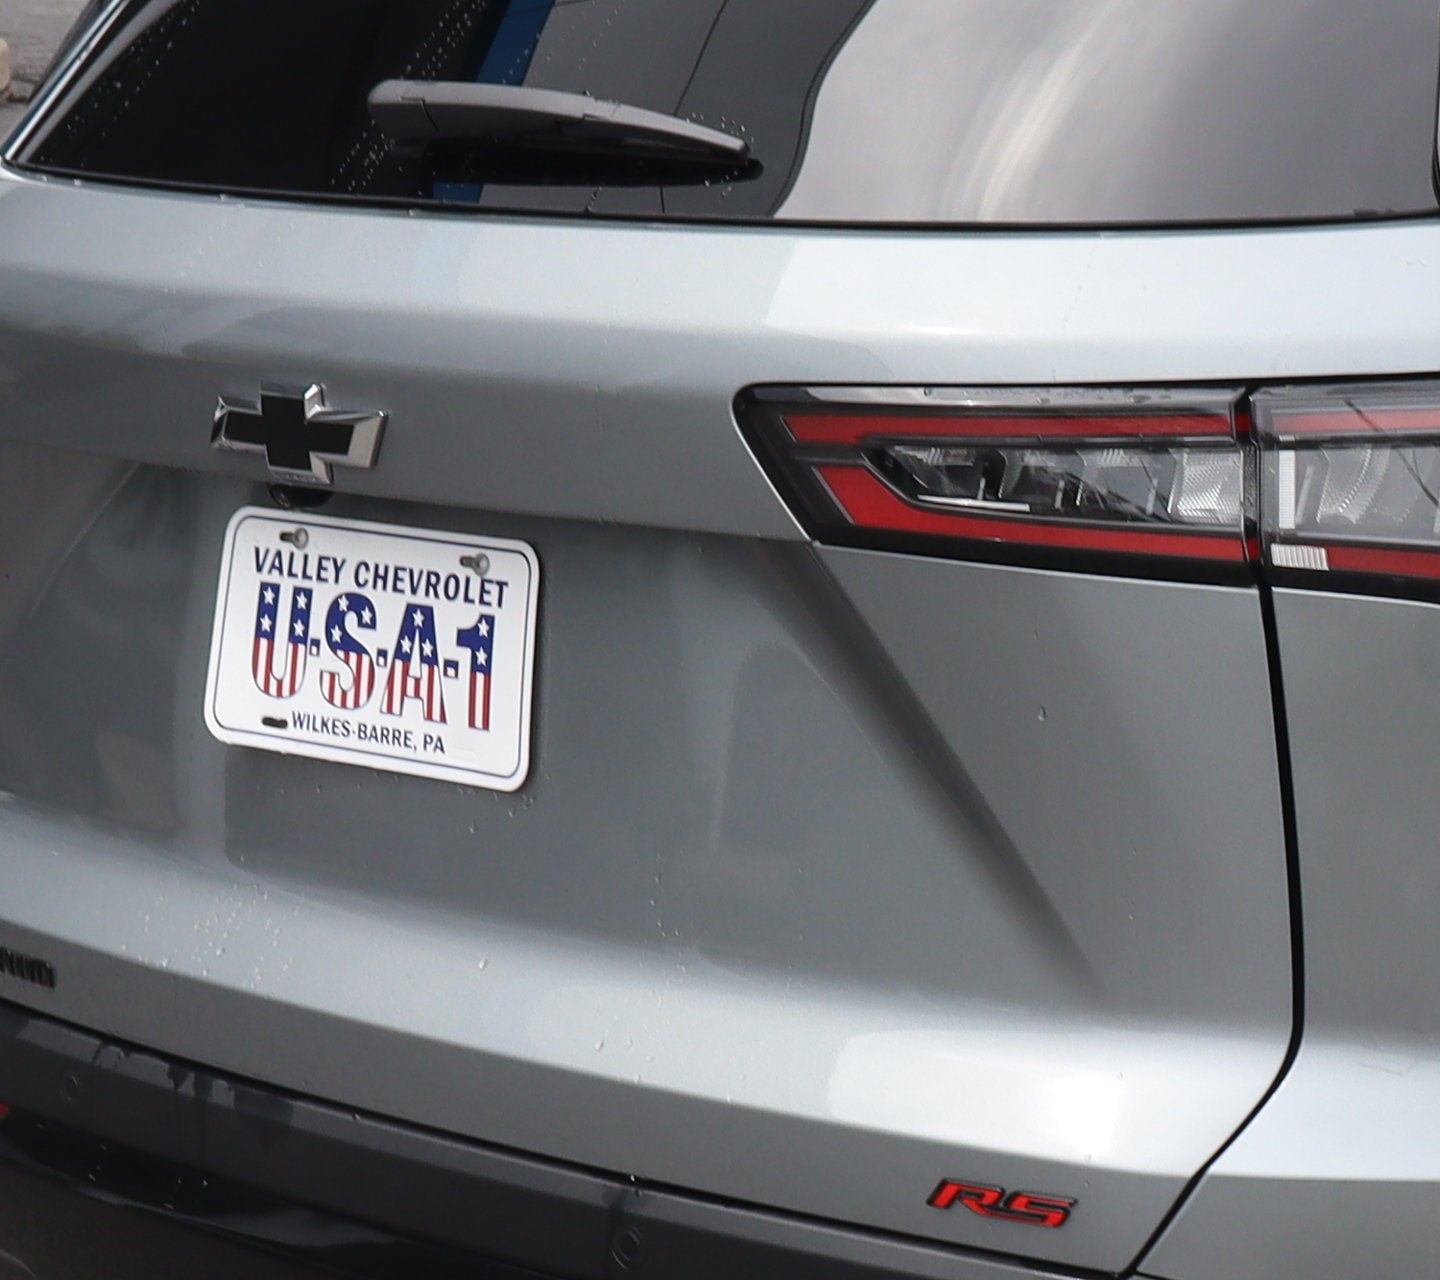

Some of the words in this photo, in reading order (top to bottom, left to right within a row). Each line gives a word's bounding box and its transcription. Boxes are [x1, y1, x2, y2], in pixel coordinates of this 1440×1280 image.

[253, 545, 346, 584] VALLEY
[353, 560, 510, 609] CHEVROLET
[291, 710, 418, 752] WILKES-BARRE,
[423, 734, 446, 755] PA
[926, 1177, 1079, 1228] RS
